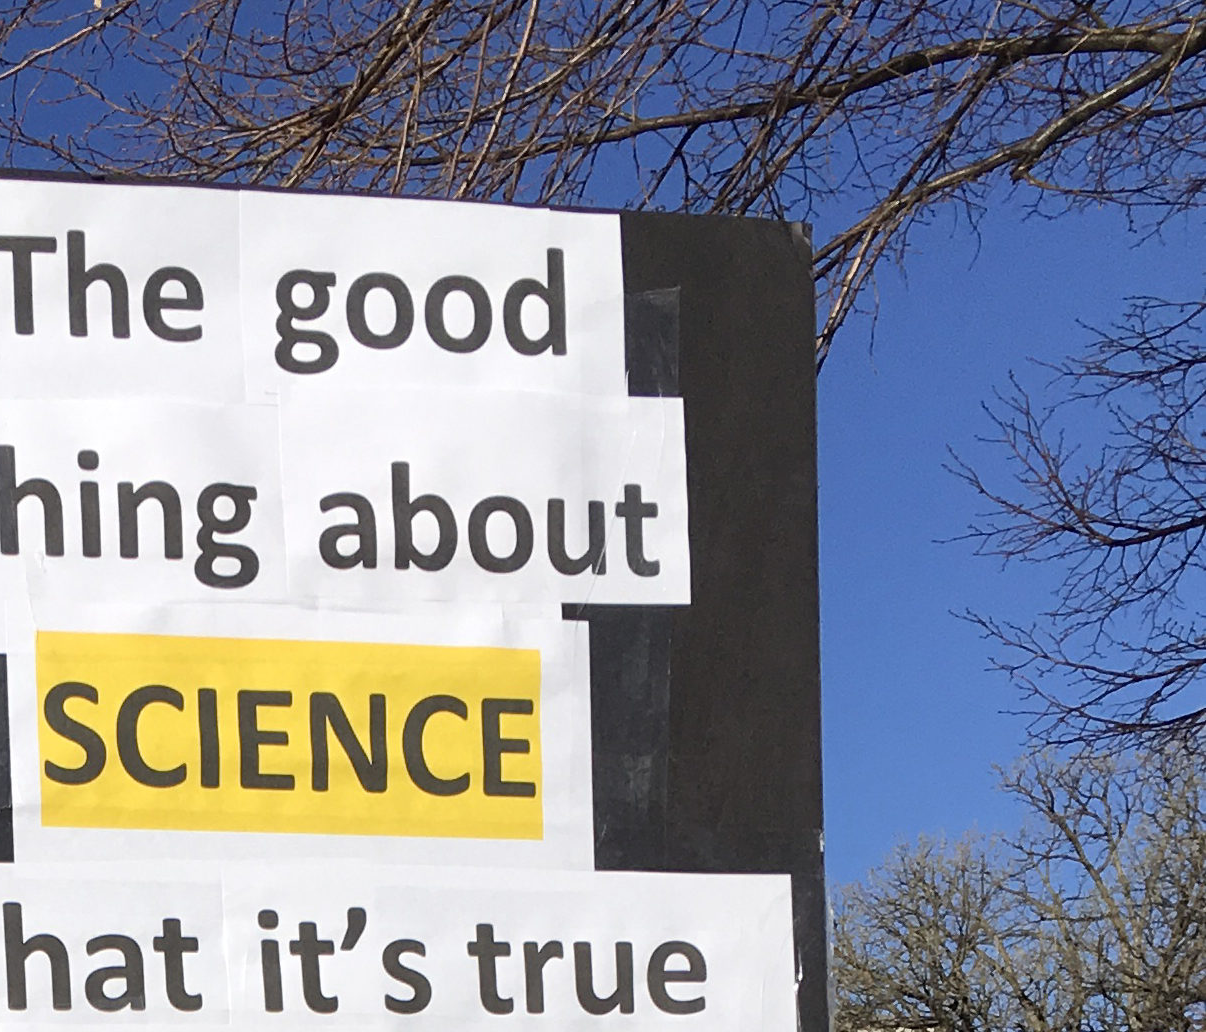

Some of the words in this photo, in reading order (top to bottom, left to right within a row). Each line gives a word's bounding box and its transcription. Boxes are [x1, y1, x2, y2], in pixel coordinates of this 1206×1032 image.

[274, 247, 568, 375] good
[318, 461, 661, 578] about
[43, 681, 538, 799] SCIENCE
[257, 907, 432, 1015] it’s
[467, 923, 708, 1016] true
